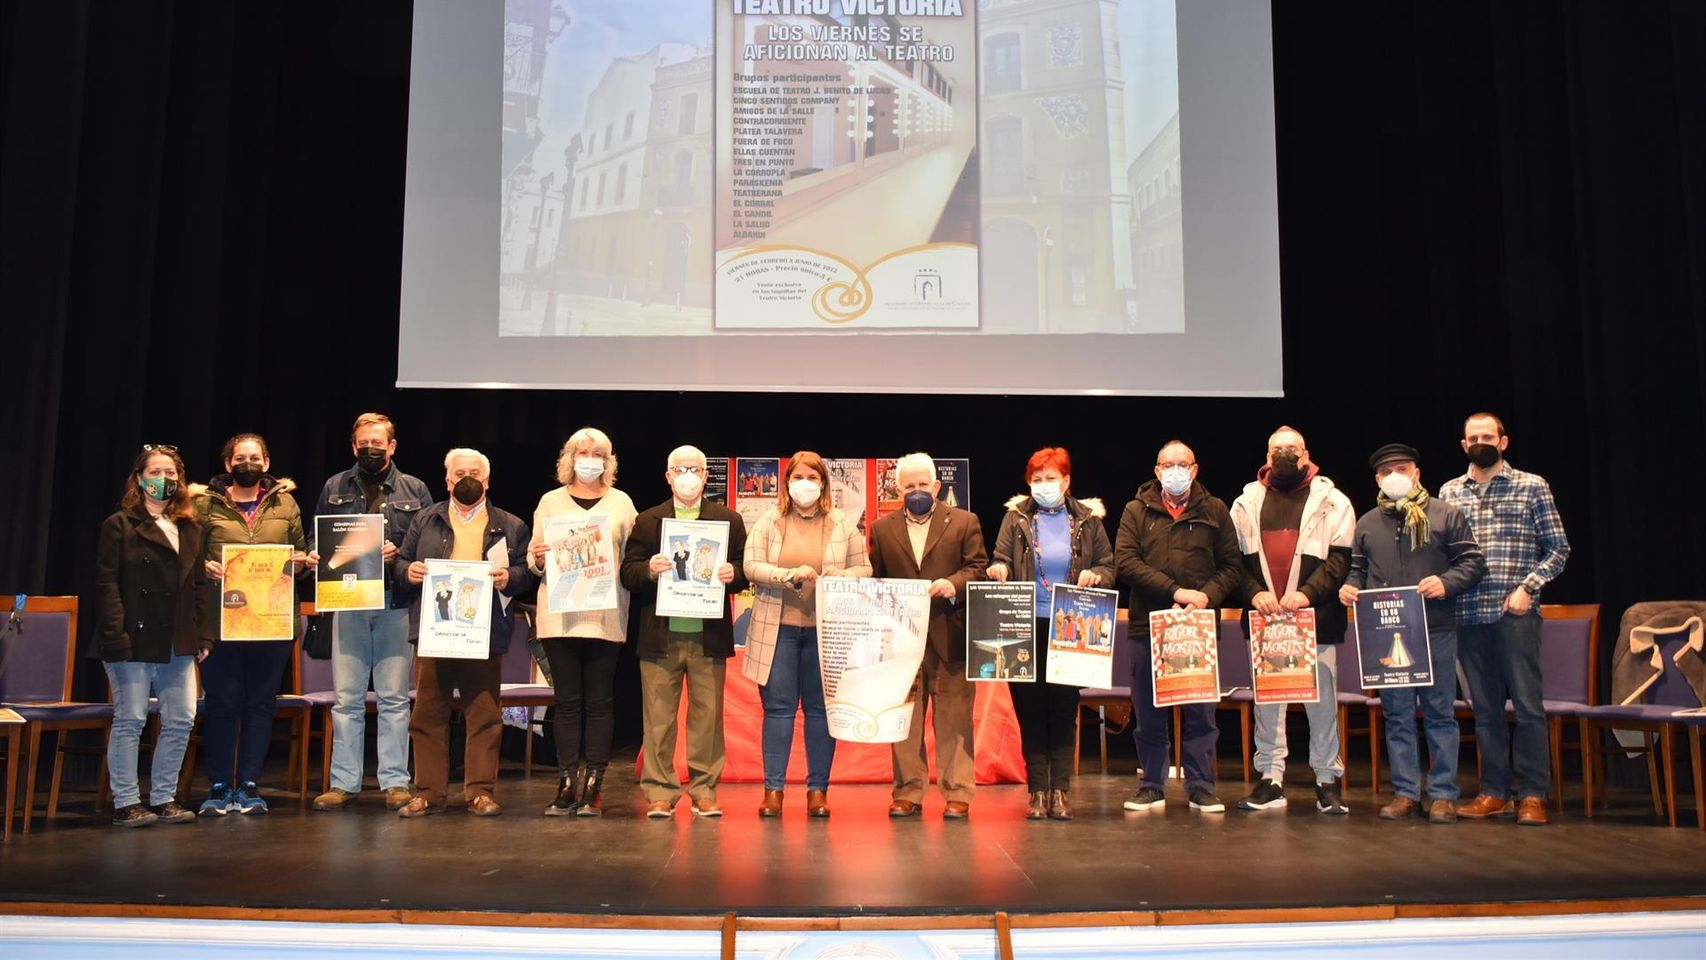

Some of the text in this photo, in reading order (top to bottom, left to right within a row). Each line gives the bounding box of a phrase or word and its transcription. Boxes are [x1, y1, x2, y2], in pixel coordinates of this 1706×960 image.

[733, 0, 963, 16] TEATRO VICTORIA
[768, 26, 922, 42] LOS VIERNES SE
[744, 44, 954, 61] AFICIONAN AL TEATRO
[733, 73, 842, 84] Grupos participantes
[828, 461, 863, 470] VICTORIA
[822, 580, 926, 596] TEATRO VICTORIA
[1373, 600, 1404, 609] HISTORIAS
[1164, 624, 1198, 640] RIGOR
[1264, 624, 1297, 639] RIGOR
[1162, 641, 1205, 656] MORTIS
[1262, 640, 1305, 656] MORTIS
